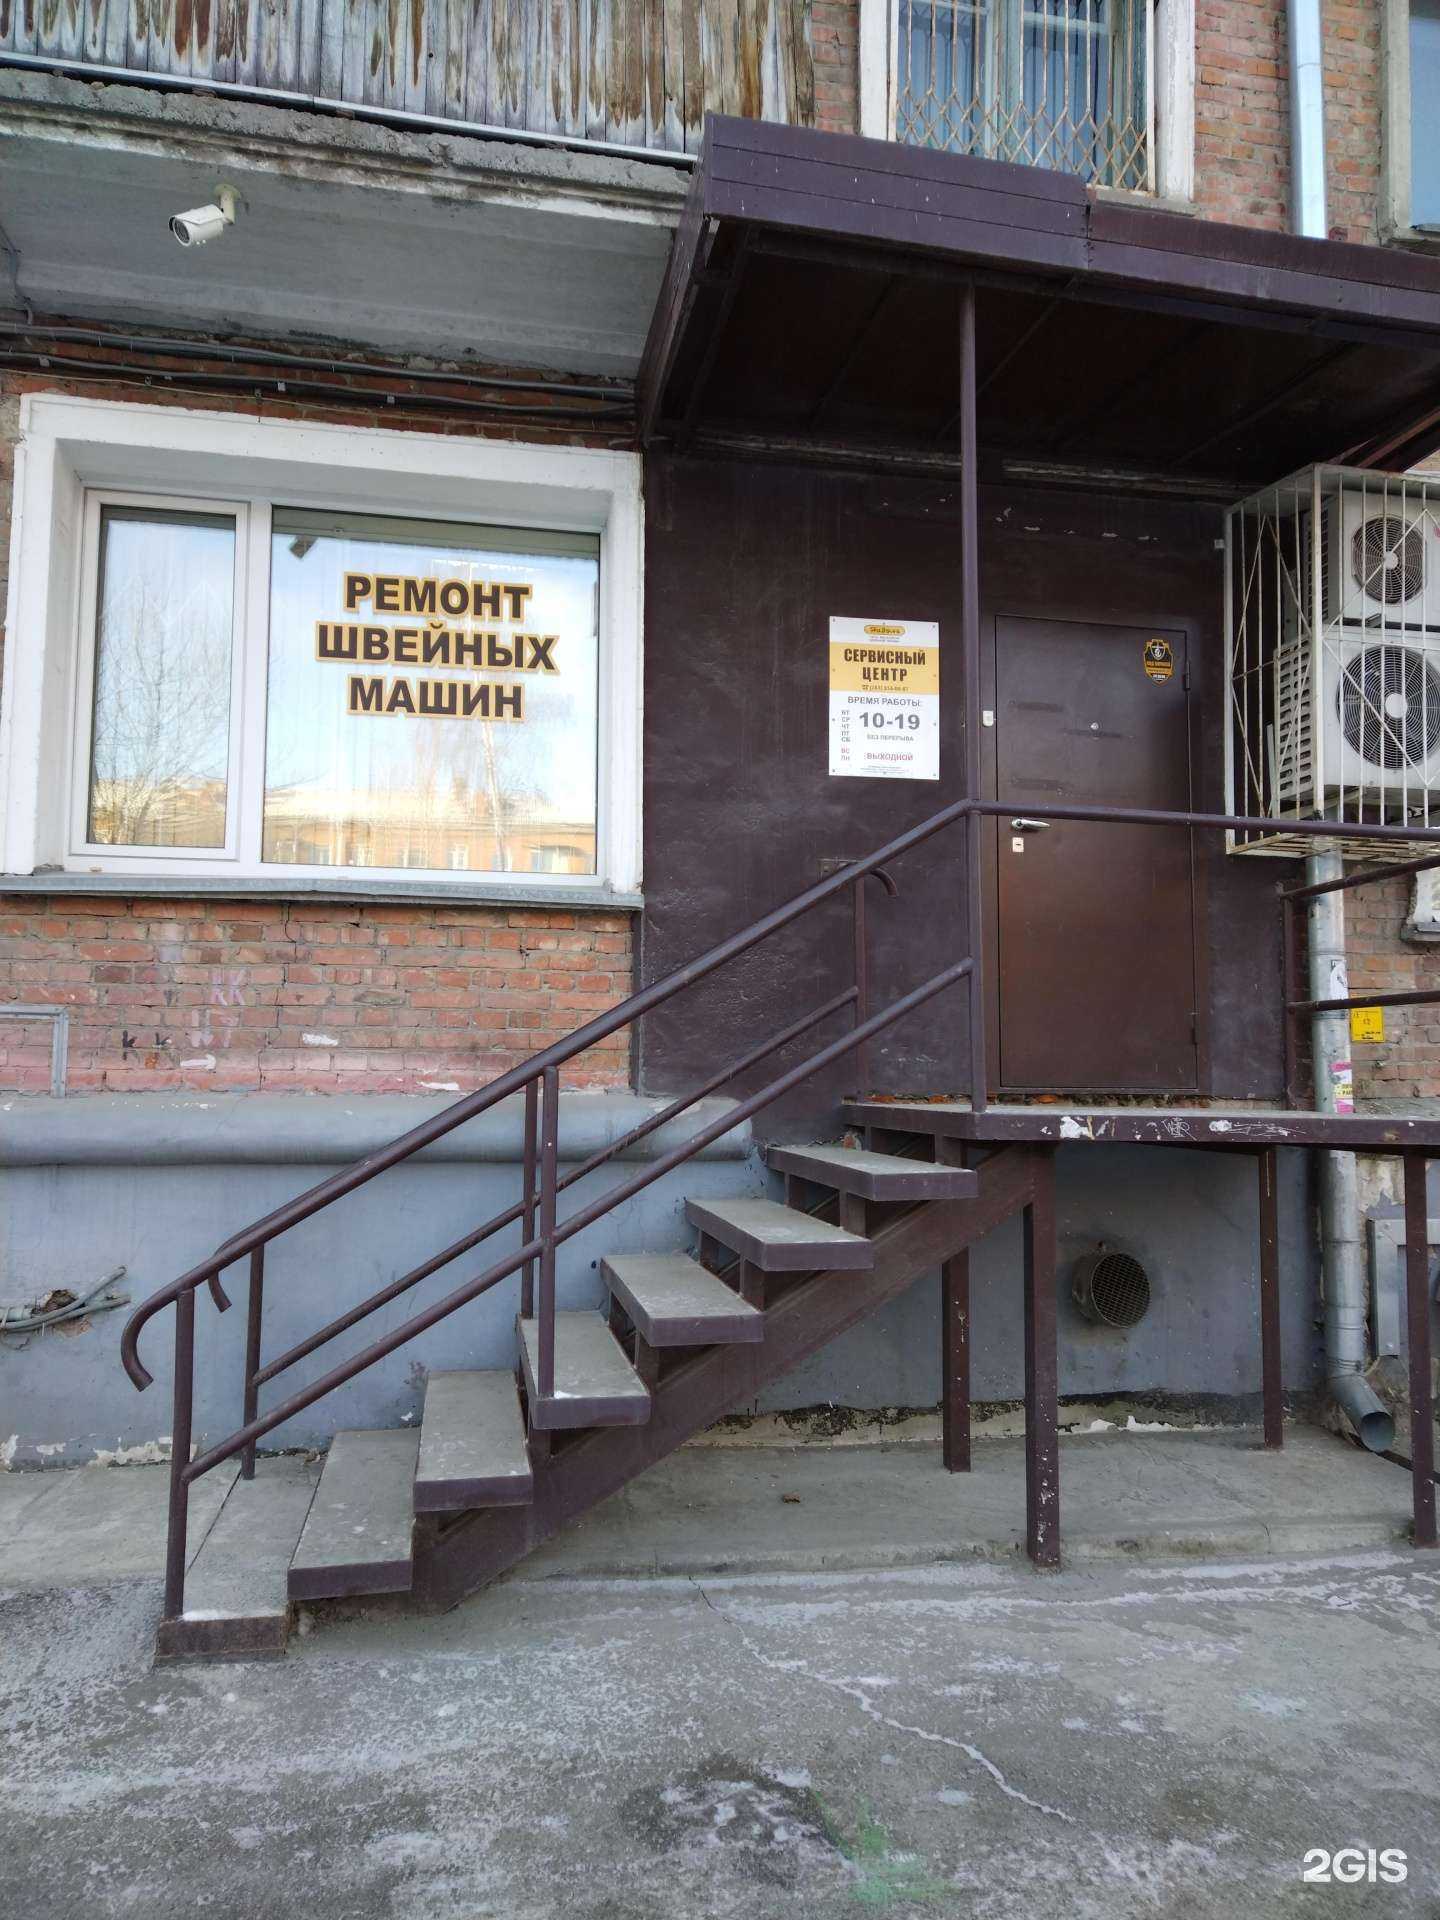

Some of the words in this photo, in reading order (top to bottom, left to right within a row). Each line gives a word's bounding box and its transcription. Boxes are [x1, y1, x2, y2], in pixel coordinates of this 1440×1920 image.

[345, 573, 532, 621] РЕМОНТ
[317, 620, 558, 673] ШВЕЙНЫХ
[844, 648, 926, 665] СЕРВИСНЫЙ
[862, 667, 908, 682] ЦЕНТР
[349, 676, 524, 721] МАШИН
[847, 696, 880, 705] ВРЕМЯ
[881, 697, 922, 707] РАБОТЫ
[859, 712, 921, 730] 10-19
[866, 752, 914, 761] ВЫХОДНОЙ
